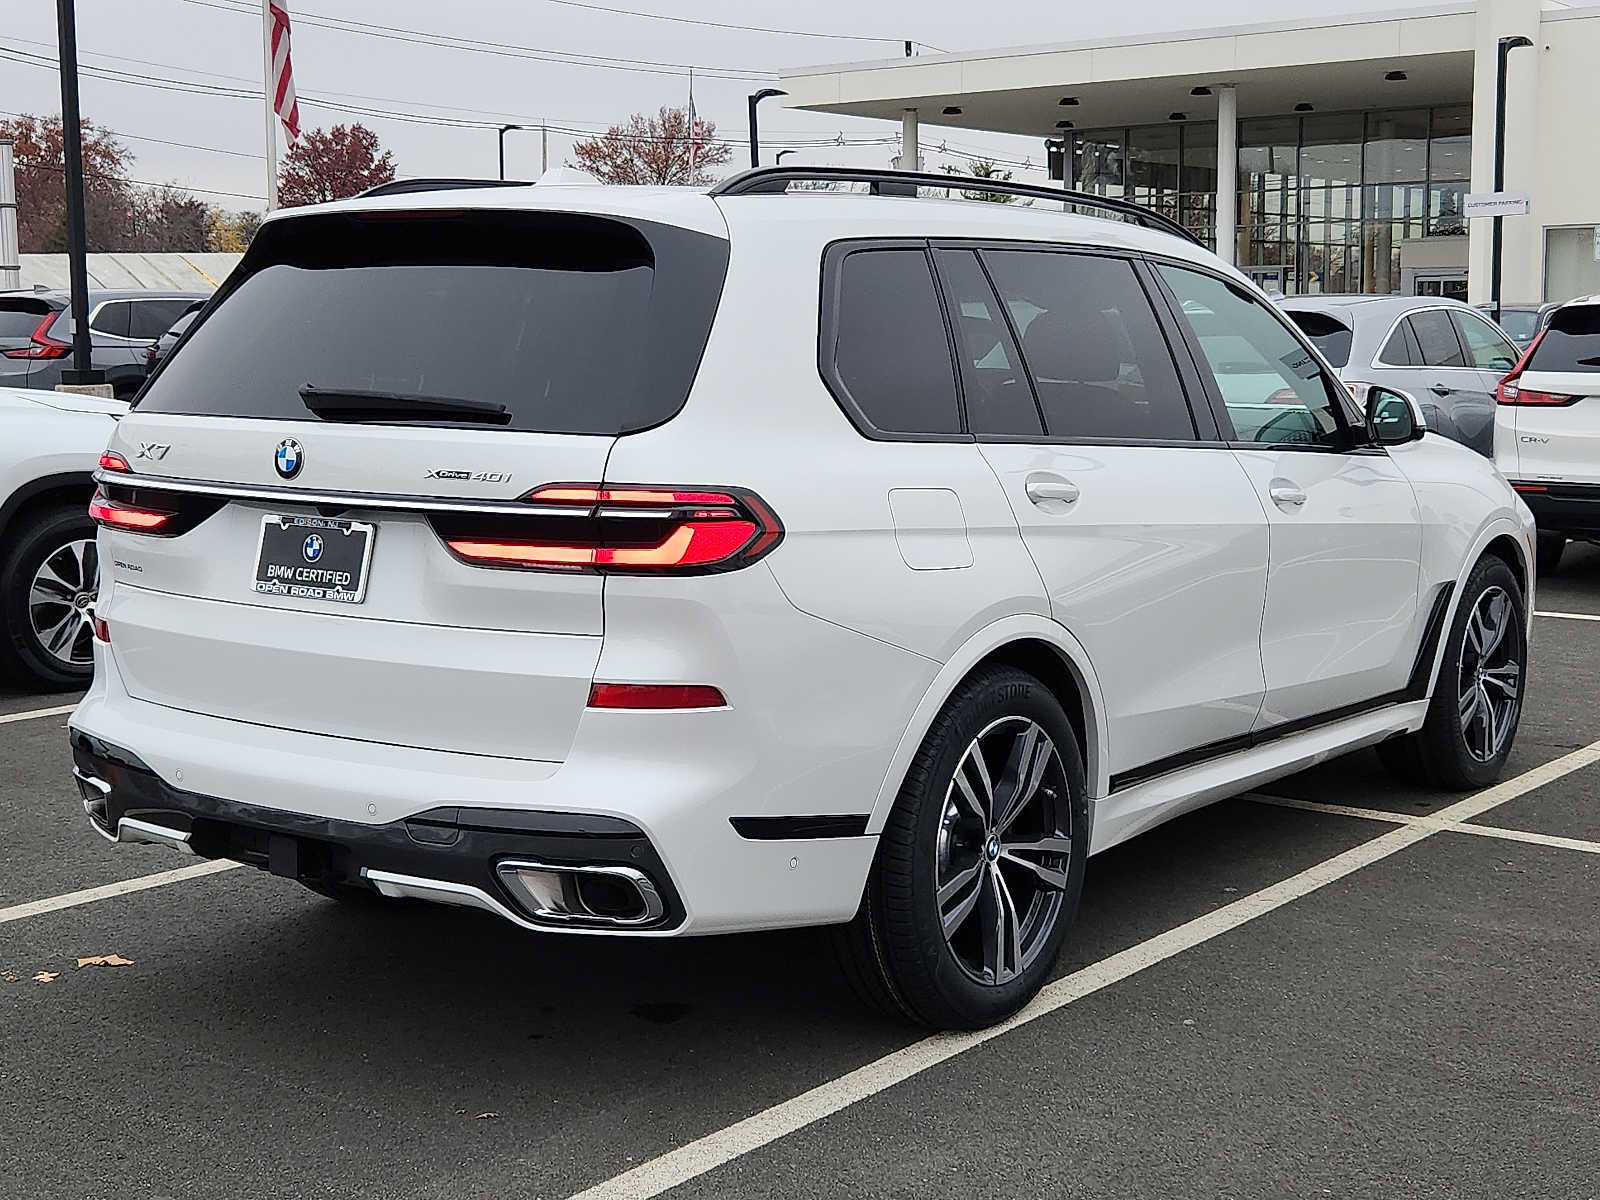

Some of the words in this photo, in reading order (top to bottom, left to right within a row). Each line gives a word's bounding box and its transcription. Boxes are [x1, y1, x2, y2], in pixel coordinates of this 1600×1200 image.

[1520, 436, 1550, 444] CR-V
[136, 442, 171, 460] X7
[267, 564, 294, 579] BMW
[295, 567, 351, 585] CERTIFIED
[256, 583, 289, 594] OPEN
[290, 587, 323, 598] ROAD
[325, 590, 355, 601] BMW
